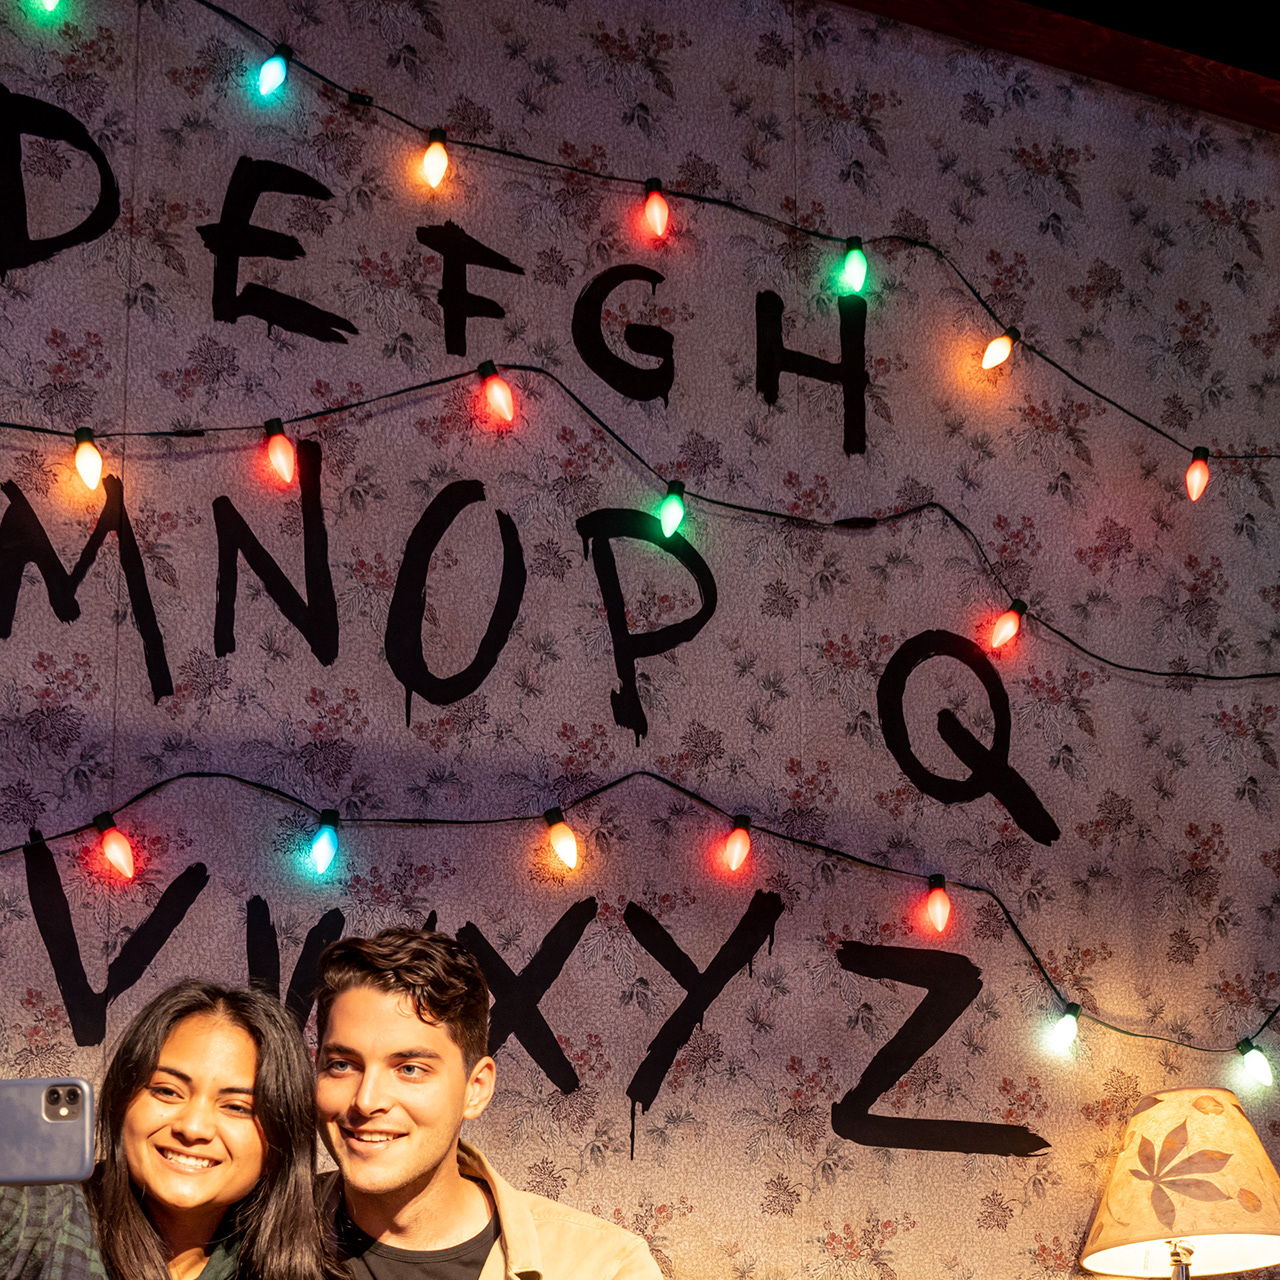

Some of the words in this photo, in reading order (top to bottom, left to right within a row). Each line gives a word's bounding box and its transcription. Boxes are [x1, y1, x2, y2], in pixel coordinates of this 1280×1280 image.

[196, 156, 358, 344] E
[415, 220, 525, 356] F
[571, 264, 676, 405] G
[755, 289, 870, 456] H
[213, 439, 339, 667] N
[384, 479, 525, 715] O
[576, 507, 718, 745] P
[876, 628, 1061, 846] Q
[22, 828, 211, 1047] V
[456, 897, 597, 1094] X
[623, 889, 786, 1130] Y
[831, 939, 1051, 1157] Z
